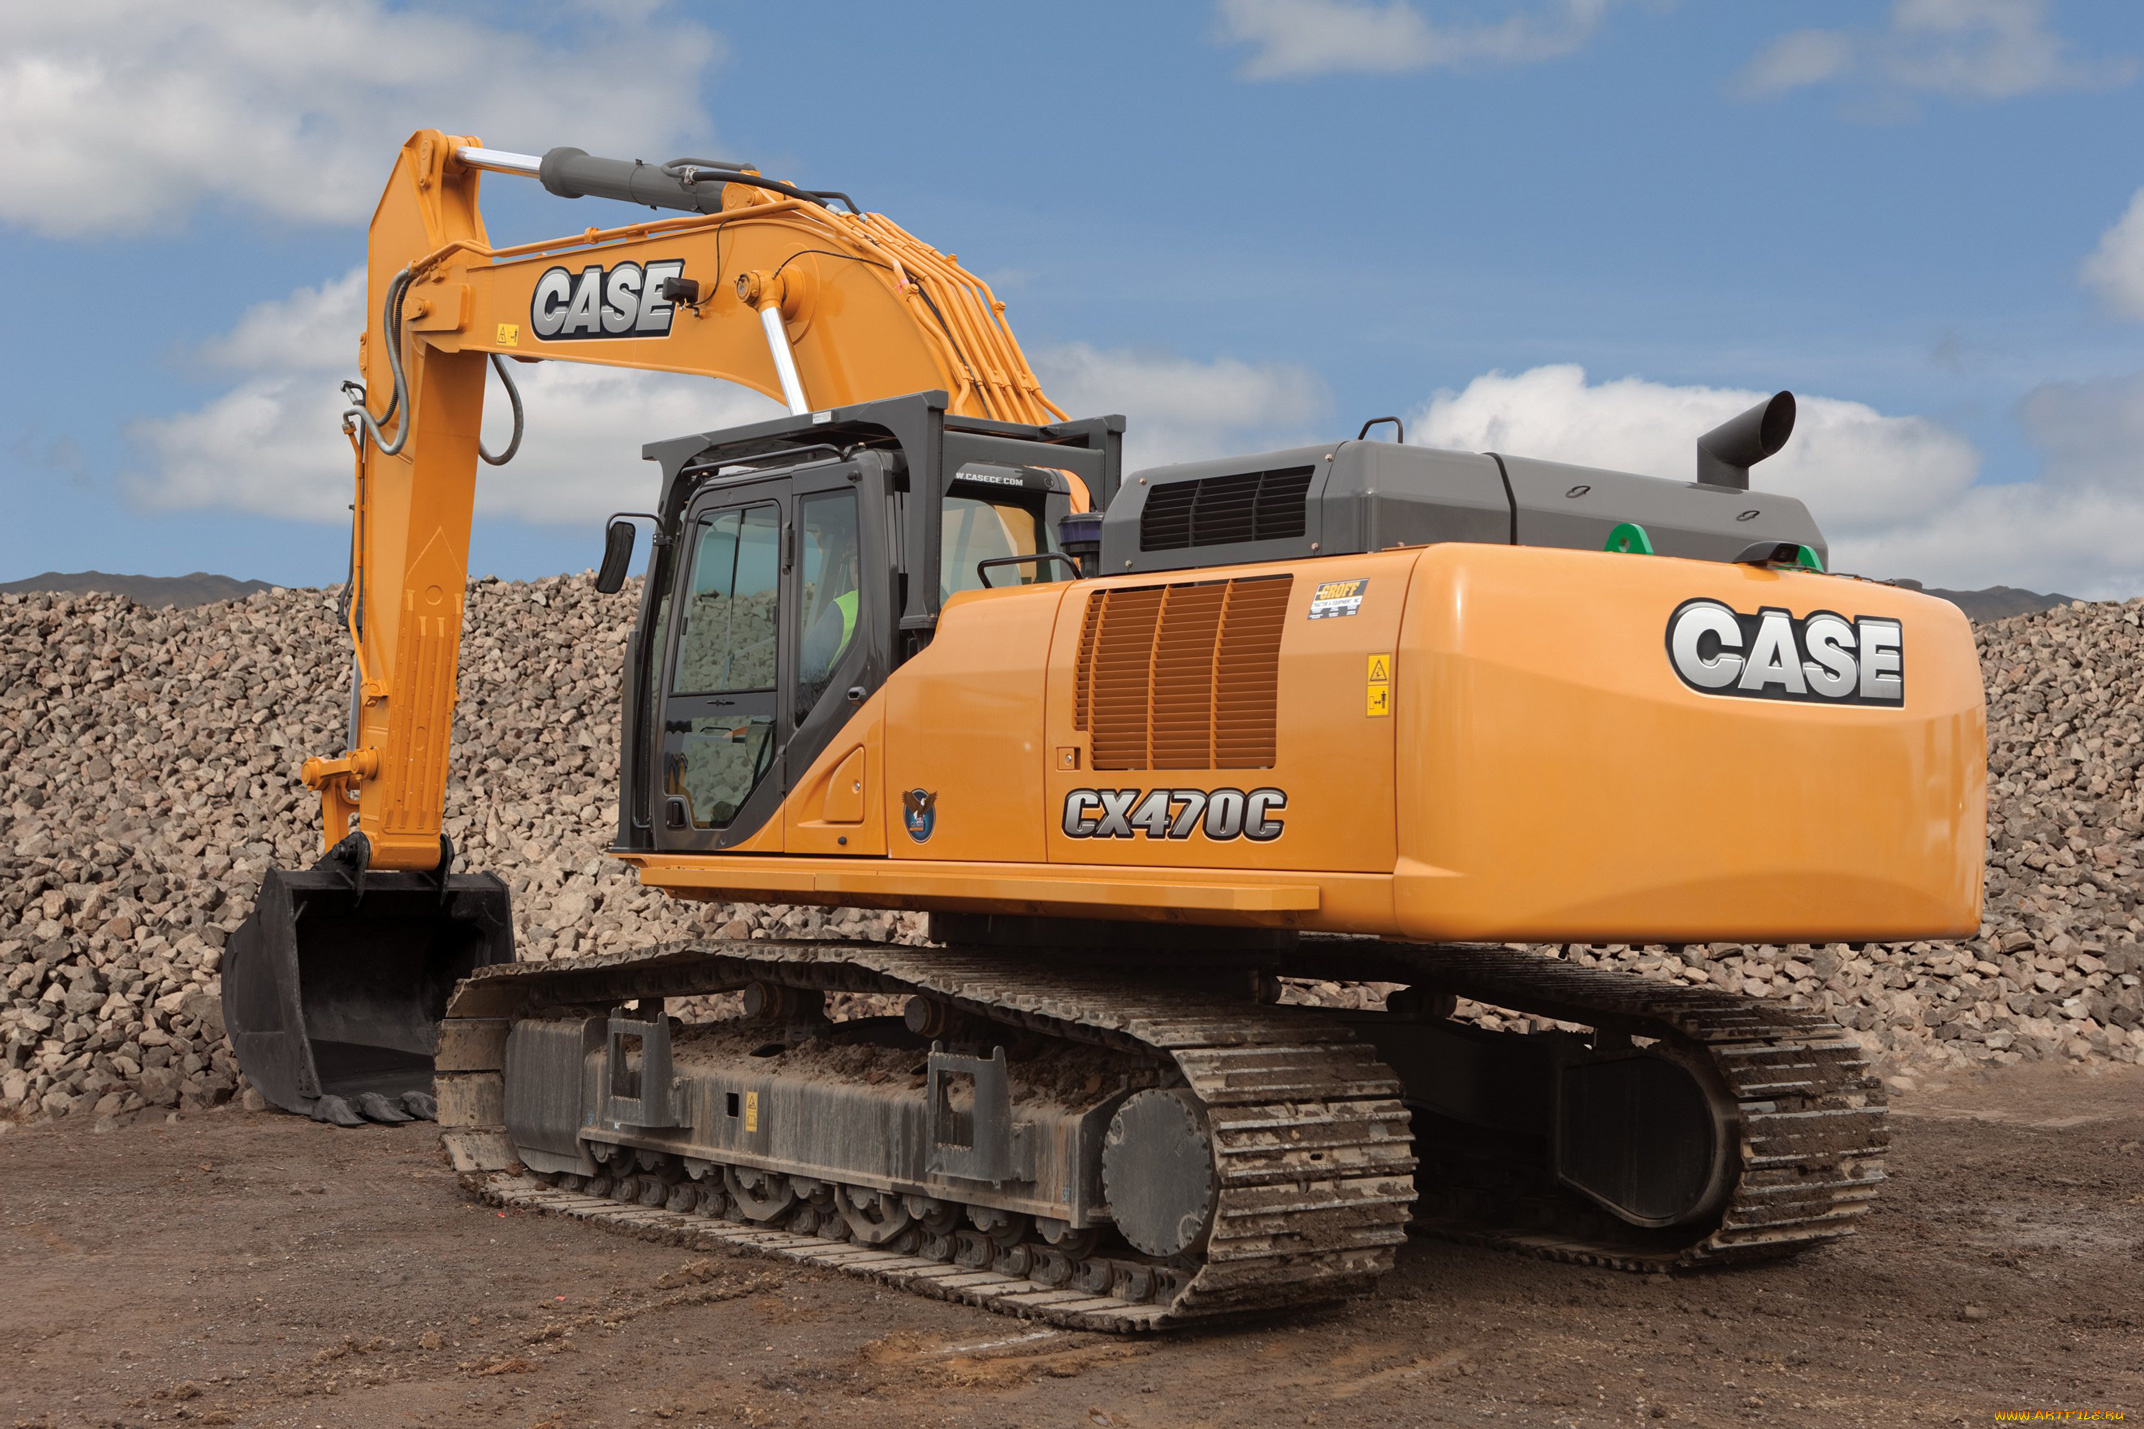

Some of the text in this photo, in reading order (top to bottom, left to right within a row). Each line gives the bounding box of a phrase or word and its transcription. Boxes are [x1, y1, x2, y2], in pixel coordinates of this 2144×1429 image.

[531, 260, 684, 340] CASE
[1317, 581, 1360, 600] GROFF
[1666, 598, 1904, 707] CASE
[1062, 787, 1287, 841] CX470C
